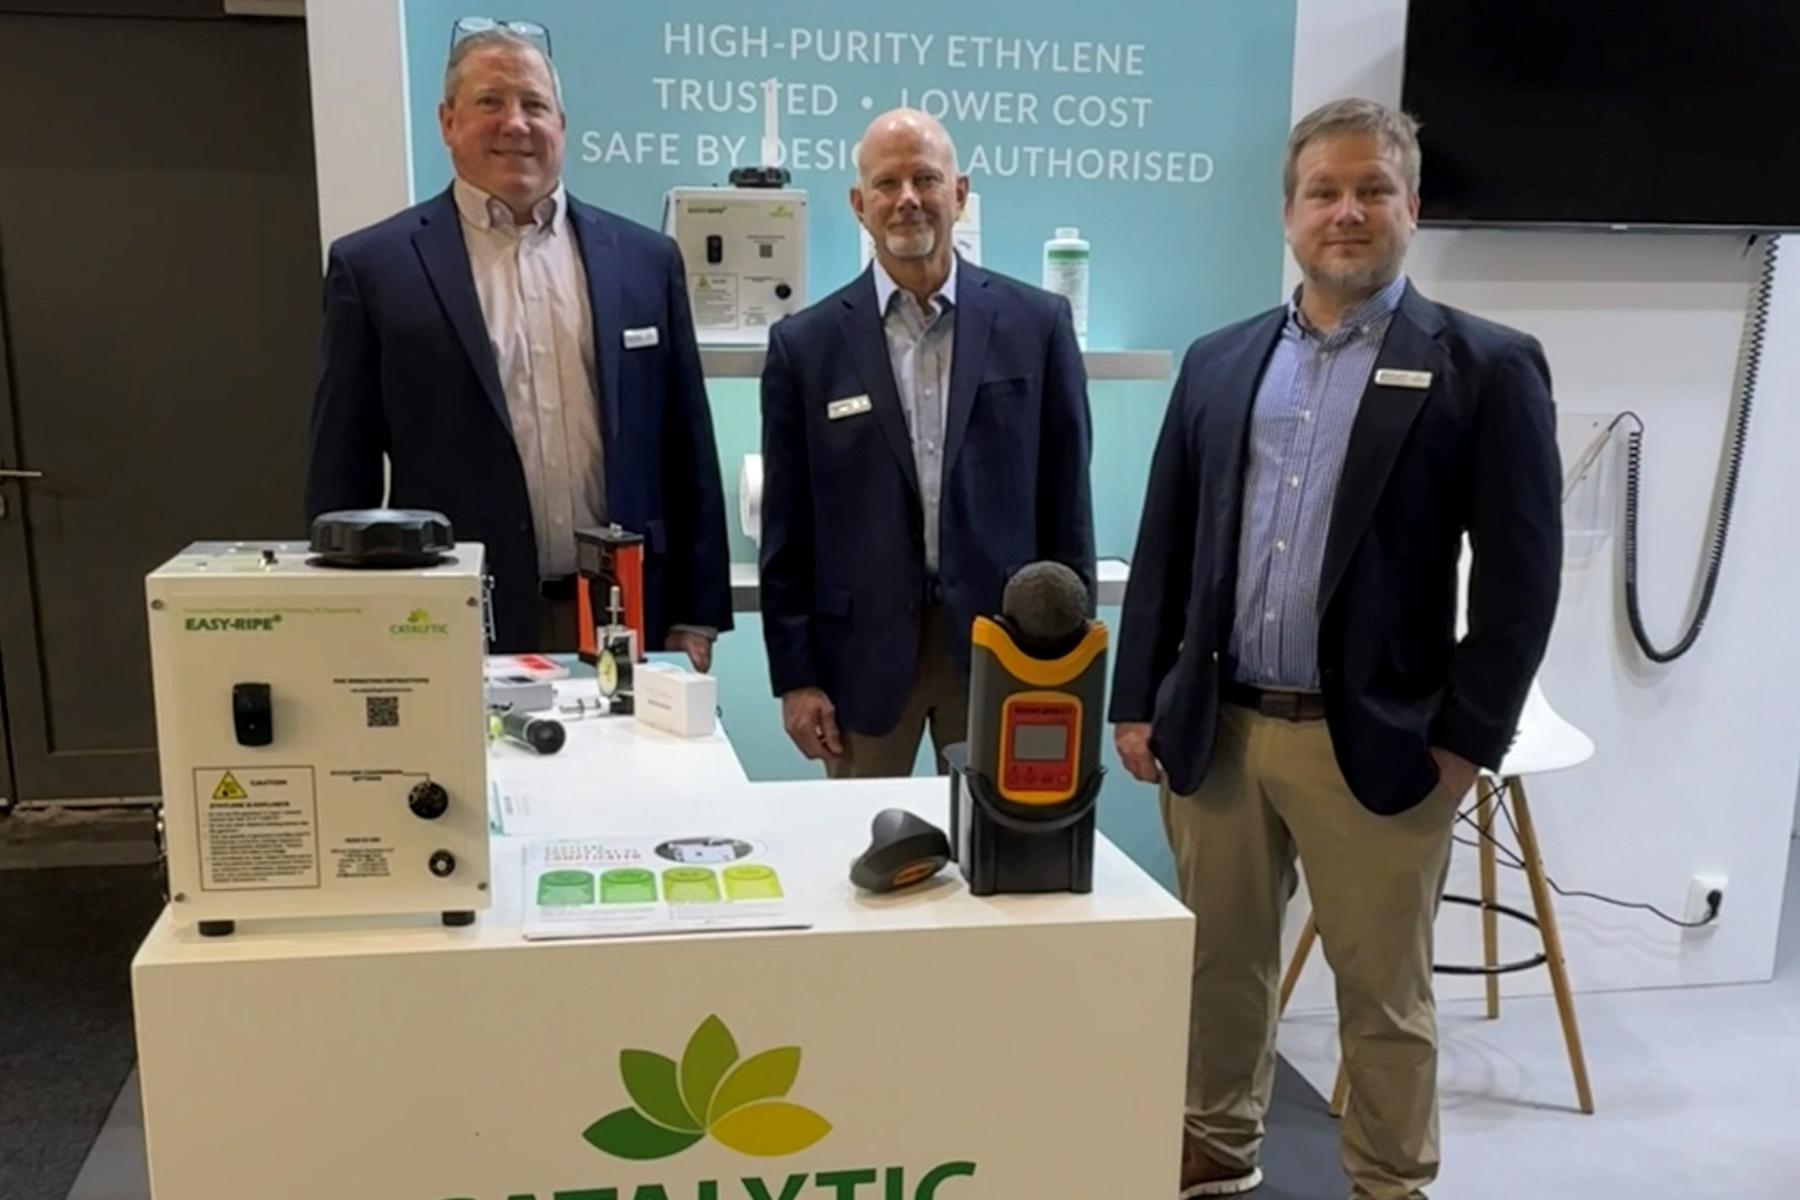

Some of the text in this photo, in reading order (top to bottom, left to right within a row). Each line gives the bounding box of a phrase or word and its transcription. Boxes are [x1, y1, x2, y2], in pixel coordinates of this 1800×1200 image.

[663, 20, 1146, 76] HIGH-PURITY ETHYLENE
[1052, 95, 1153, 128] COST
[581, 130, 1215, 183] SAFE BY DESI AUTHORISED
